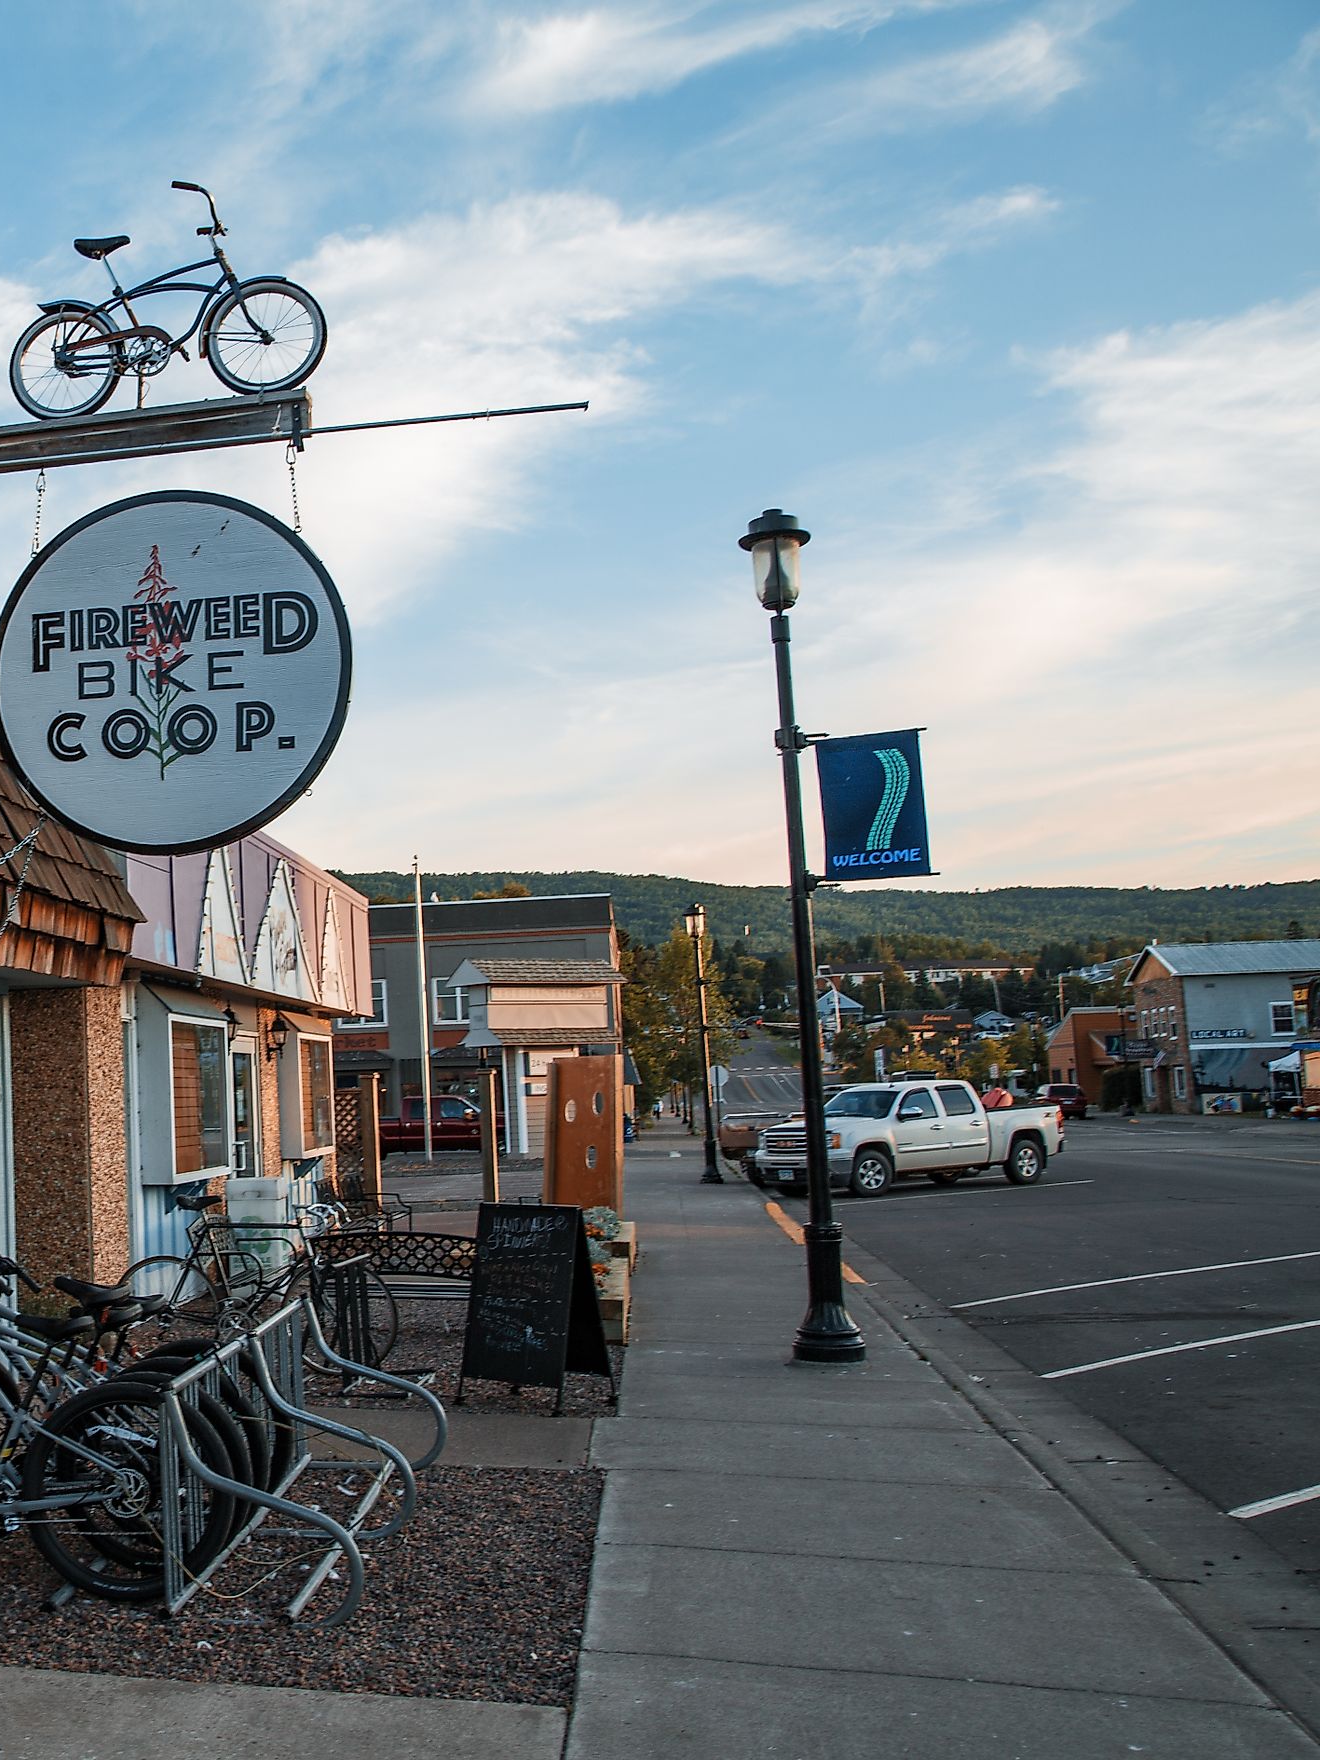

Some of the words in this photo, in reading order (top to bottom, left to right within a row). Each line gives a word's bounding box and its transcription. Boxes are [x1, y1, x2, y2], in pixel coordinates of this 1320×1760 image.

[32, 590, 319, 674] FIREWEED
[78, 650, 246, 701] BIKE
[46, 700, 296, 763] COOP.
[832, 847, 922, 867] WELCOME
[1191, 1030, 1224, 1039] LOCAL
[1226, 1028, 1246, 1038] ART
